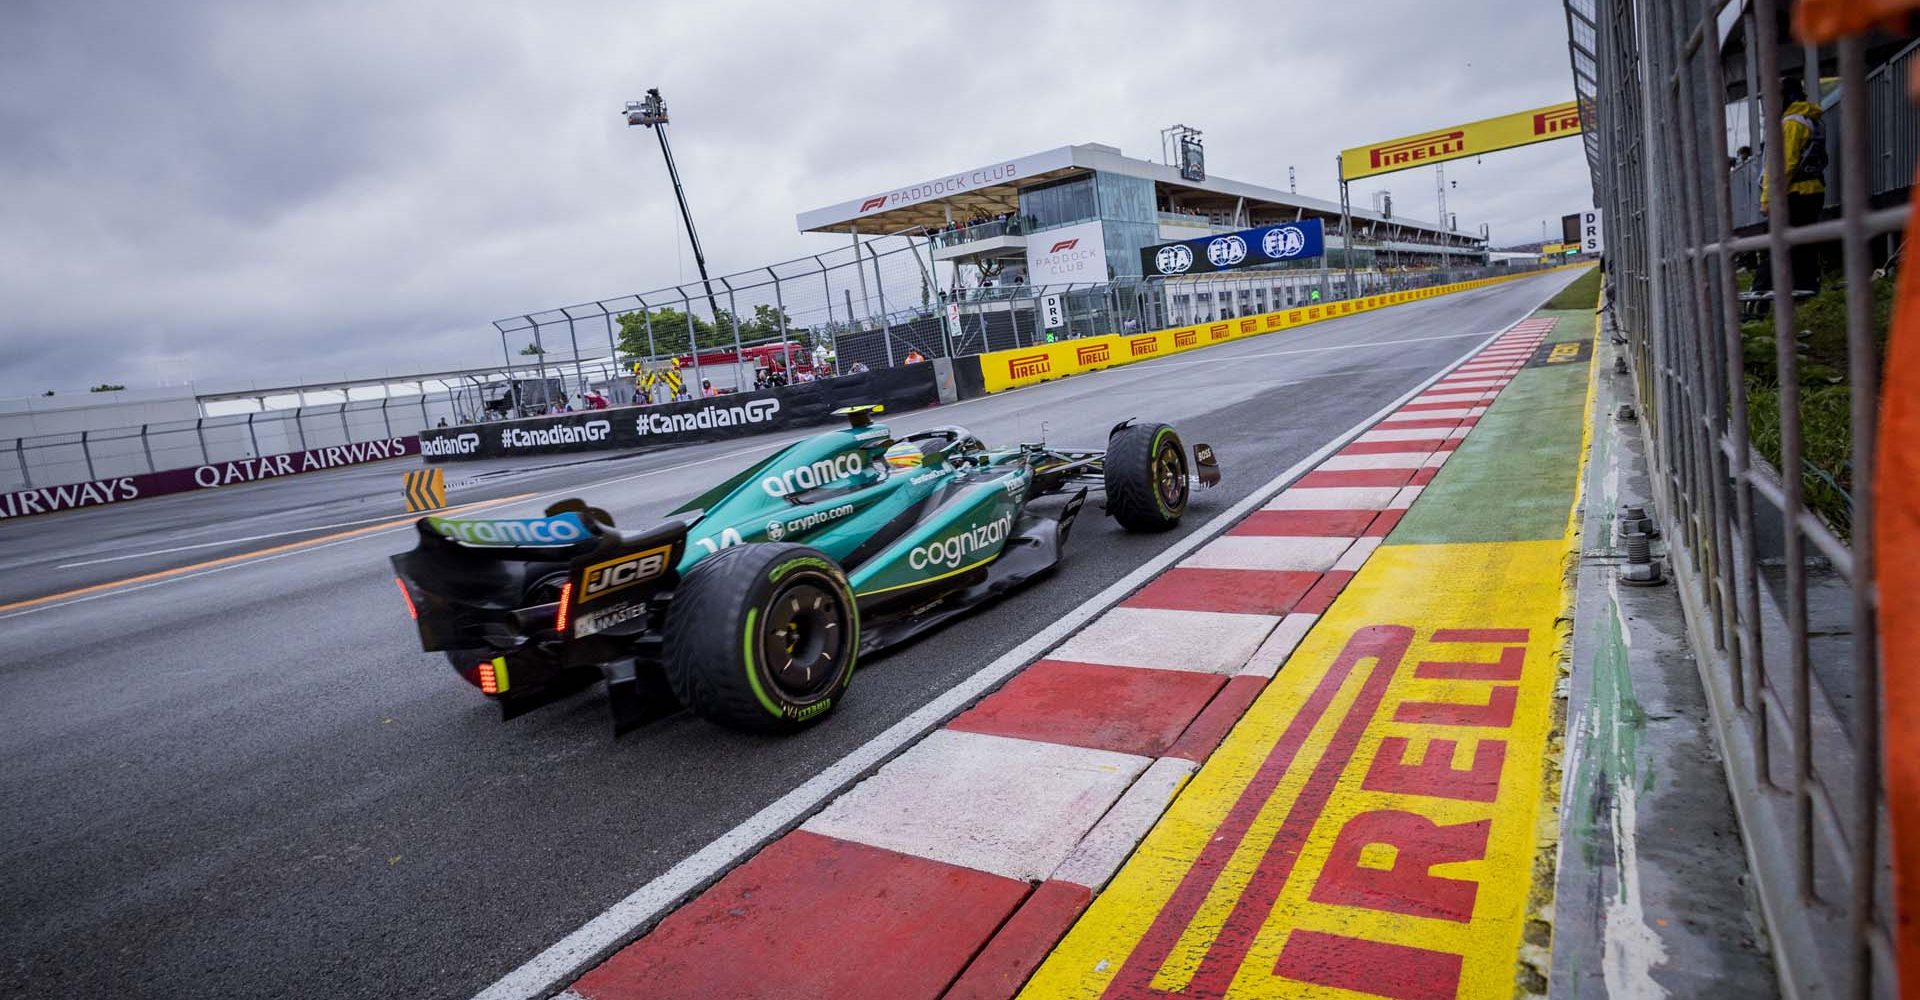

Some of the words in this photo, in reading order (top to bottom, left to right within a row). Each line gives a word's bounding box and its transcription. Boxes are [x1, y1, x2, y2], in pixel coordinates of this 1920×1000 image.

[1370, 131, 1465, 169] PIRELLI
[891, 178, 966, 205] PADDOCK
[972, 164, 1017, 184] CLUB
[1586, 213, 1597, 249] DRS
[1035, 248, 1097, 268] PADDOCK
[1050, 261, 1084, 275] CLUB
[1048, 298, 1058, 325] DRS
[1130, 336, 1158, 356] PIRELLI
[1174, 330, 1197, 347] PIRELLI
[1008, 353, 1051, 379] PIRELLI
[1076, 343, 1109, 366] PIRELLI
[636, 398, 780, 436] #CanadianGP
[501, 420, 611, 448] #CanadianGP
[194, 454, 295, 488] QATAR
[302, 437, 405, 471] AIRWAYS
[762, 452, 862, 497] aramco
[440, 520, 580, 543] aramco
[787, 504, 854, 532] crypto.com
[909, 511, 1012, 570] cognizant
[587, 554, 663, 593] JCB
[1100, 624, 1530, 1000] PIRELLI
